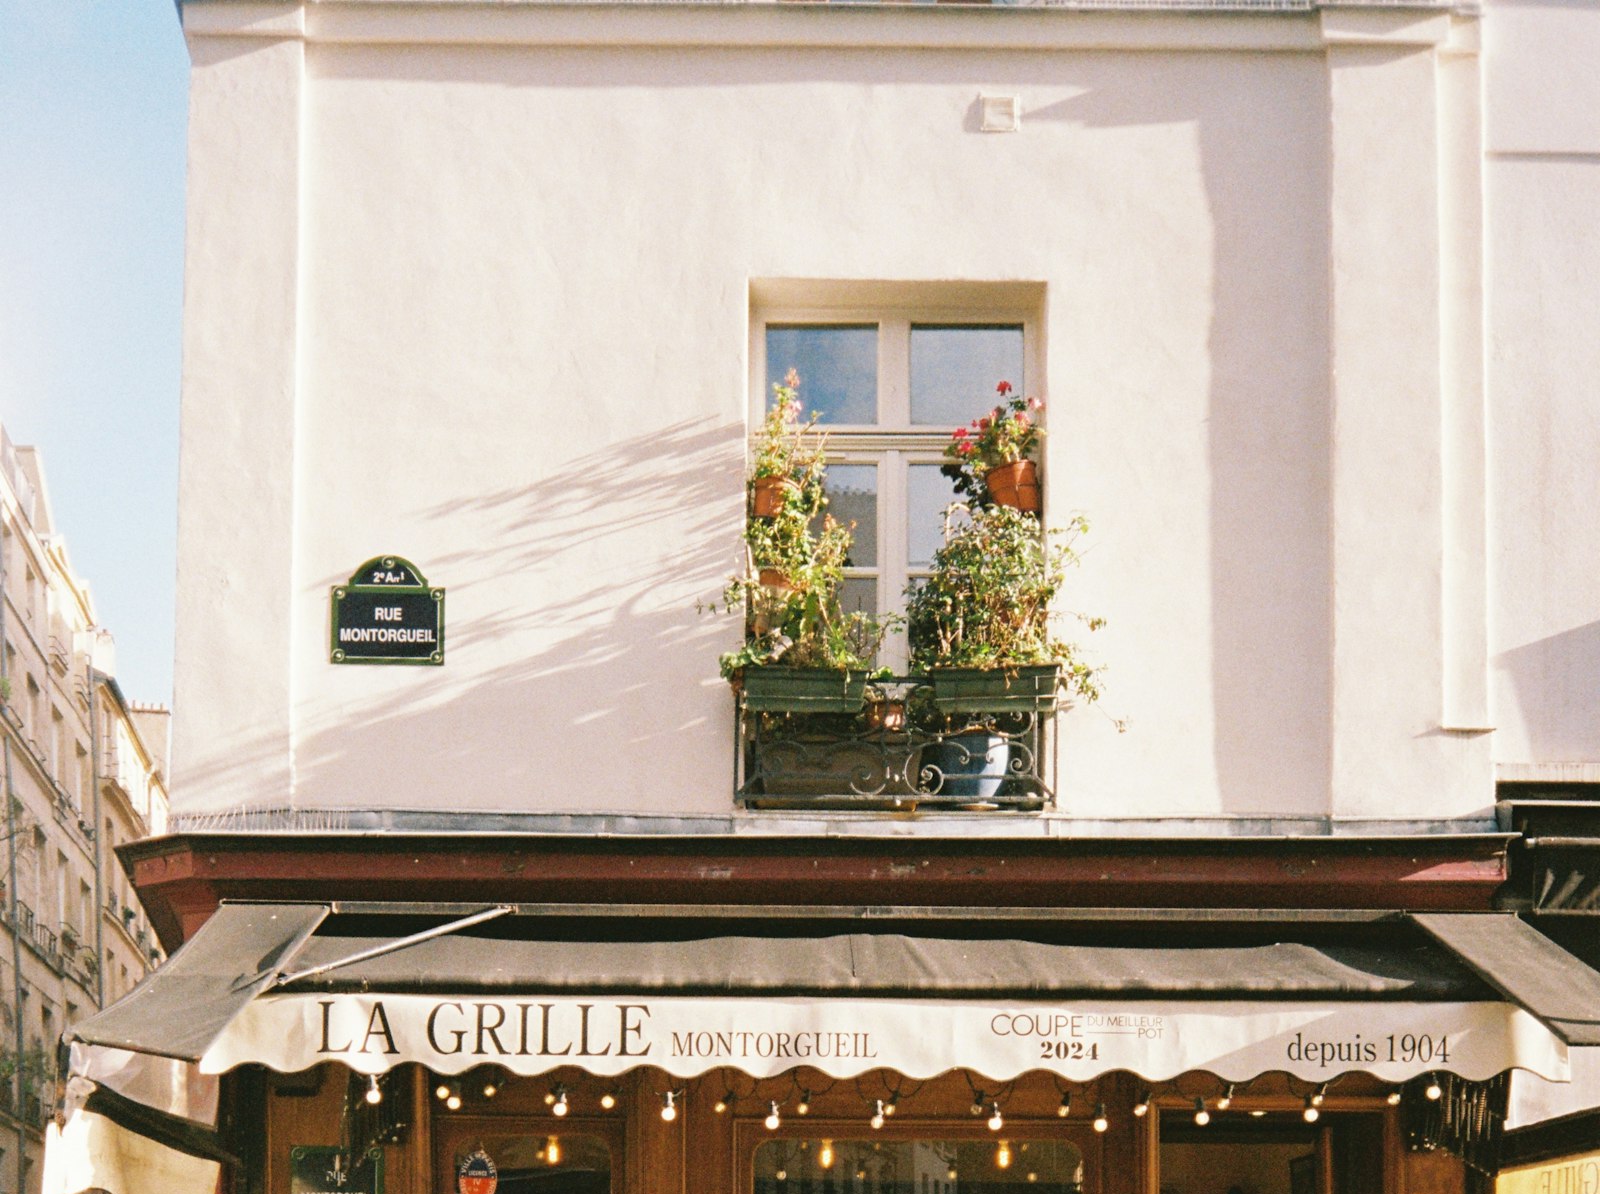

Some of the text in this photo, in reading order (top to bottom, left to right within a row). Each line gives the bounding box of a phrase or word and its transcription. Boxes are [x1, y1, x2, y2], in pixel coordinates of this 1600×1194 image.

[374, 607, 402, 621] RUE
[339, 628, 437, 643] MONTORGUEIL
[316, 1000, 878, 1059] LA GRILLE MONTORGUEIL
[990, 1013, 1164, 1038] COUPE DU MEILLEUR
[1137, 1027, 1165, 1040] POT
[1040, 1040, 1100, 1061] 2024
[1286, 1033, 1451, 1067] depuis 1904
